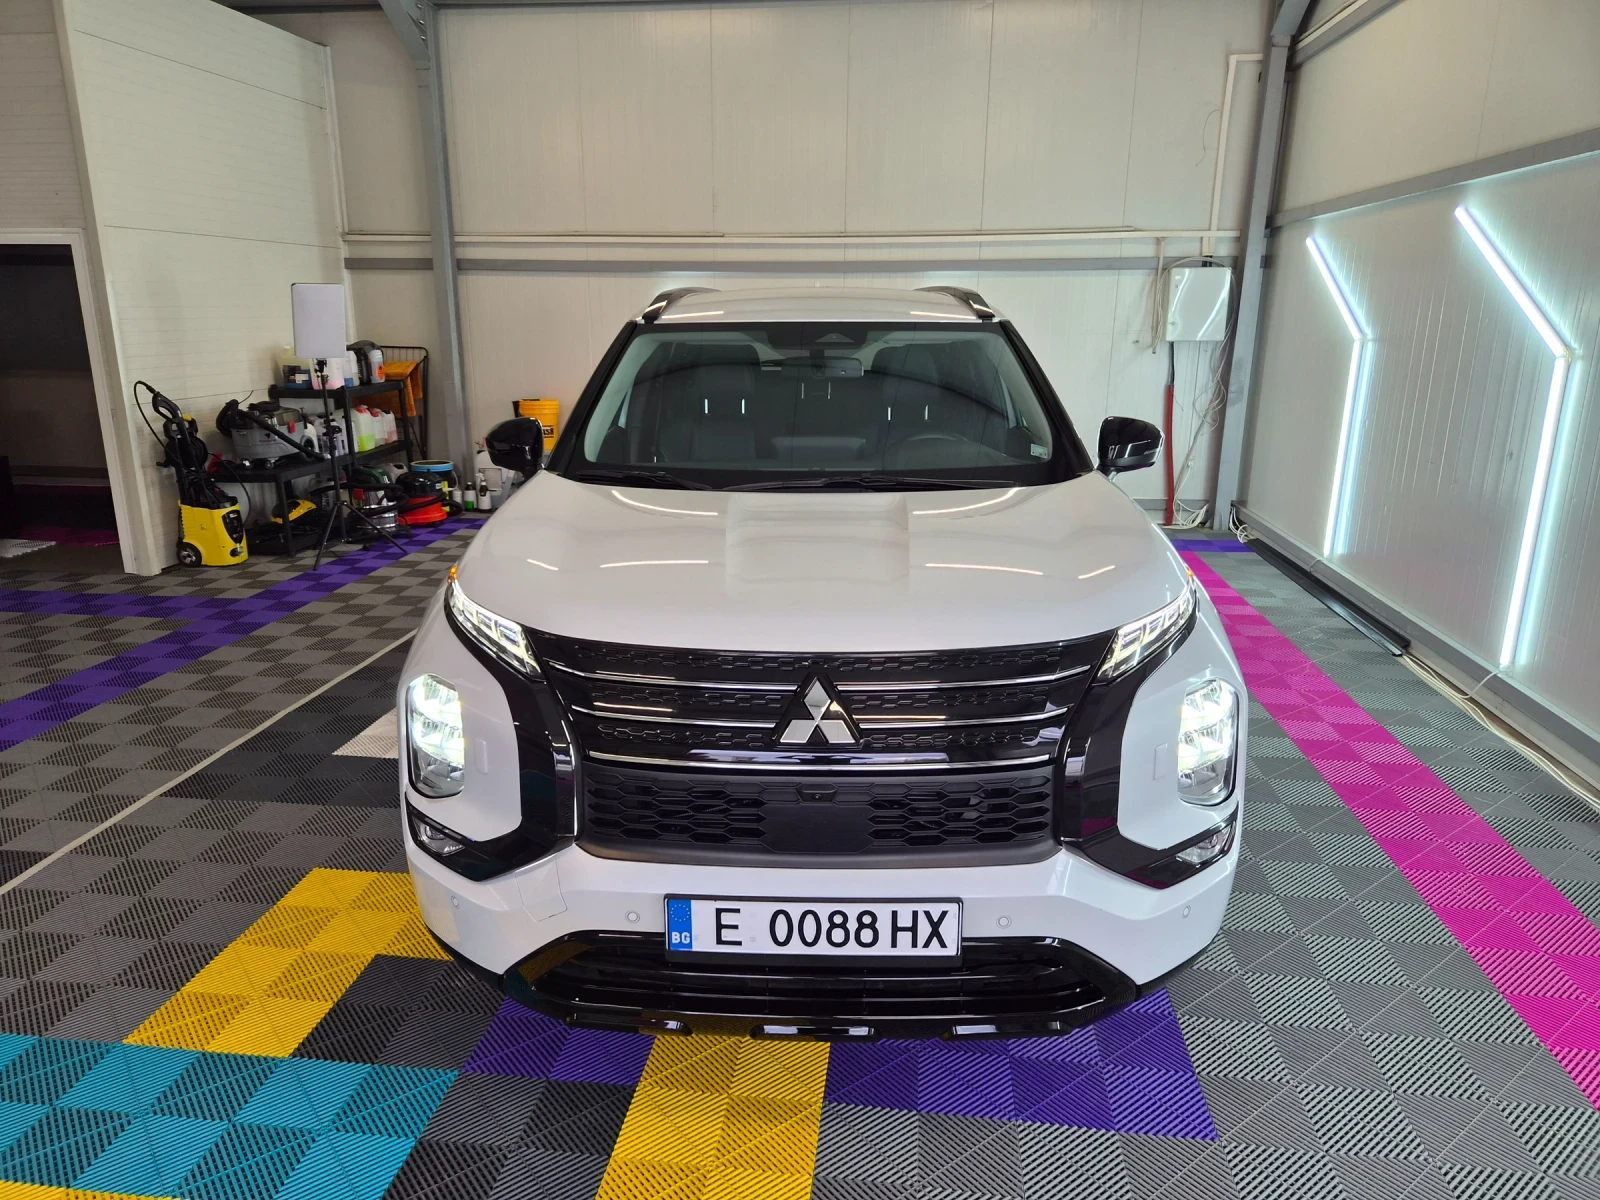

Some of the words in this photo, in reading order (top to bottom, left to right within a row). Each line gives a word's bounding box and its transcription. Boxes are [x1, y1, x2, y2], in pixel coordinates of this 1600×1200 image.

[671, 931, 691, 944] BG
[715, 907, 743, 946] E
[769, 909, 880, 948] 0088
[890, 910, 949, 949] HX
